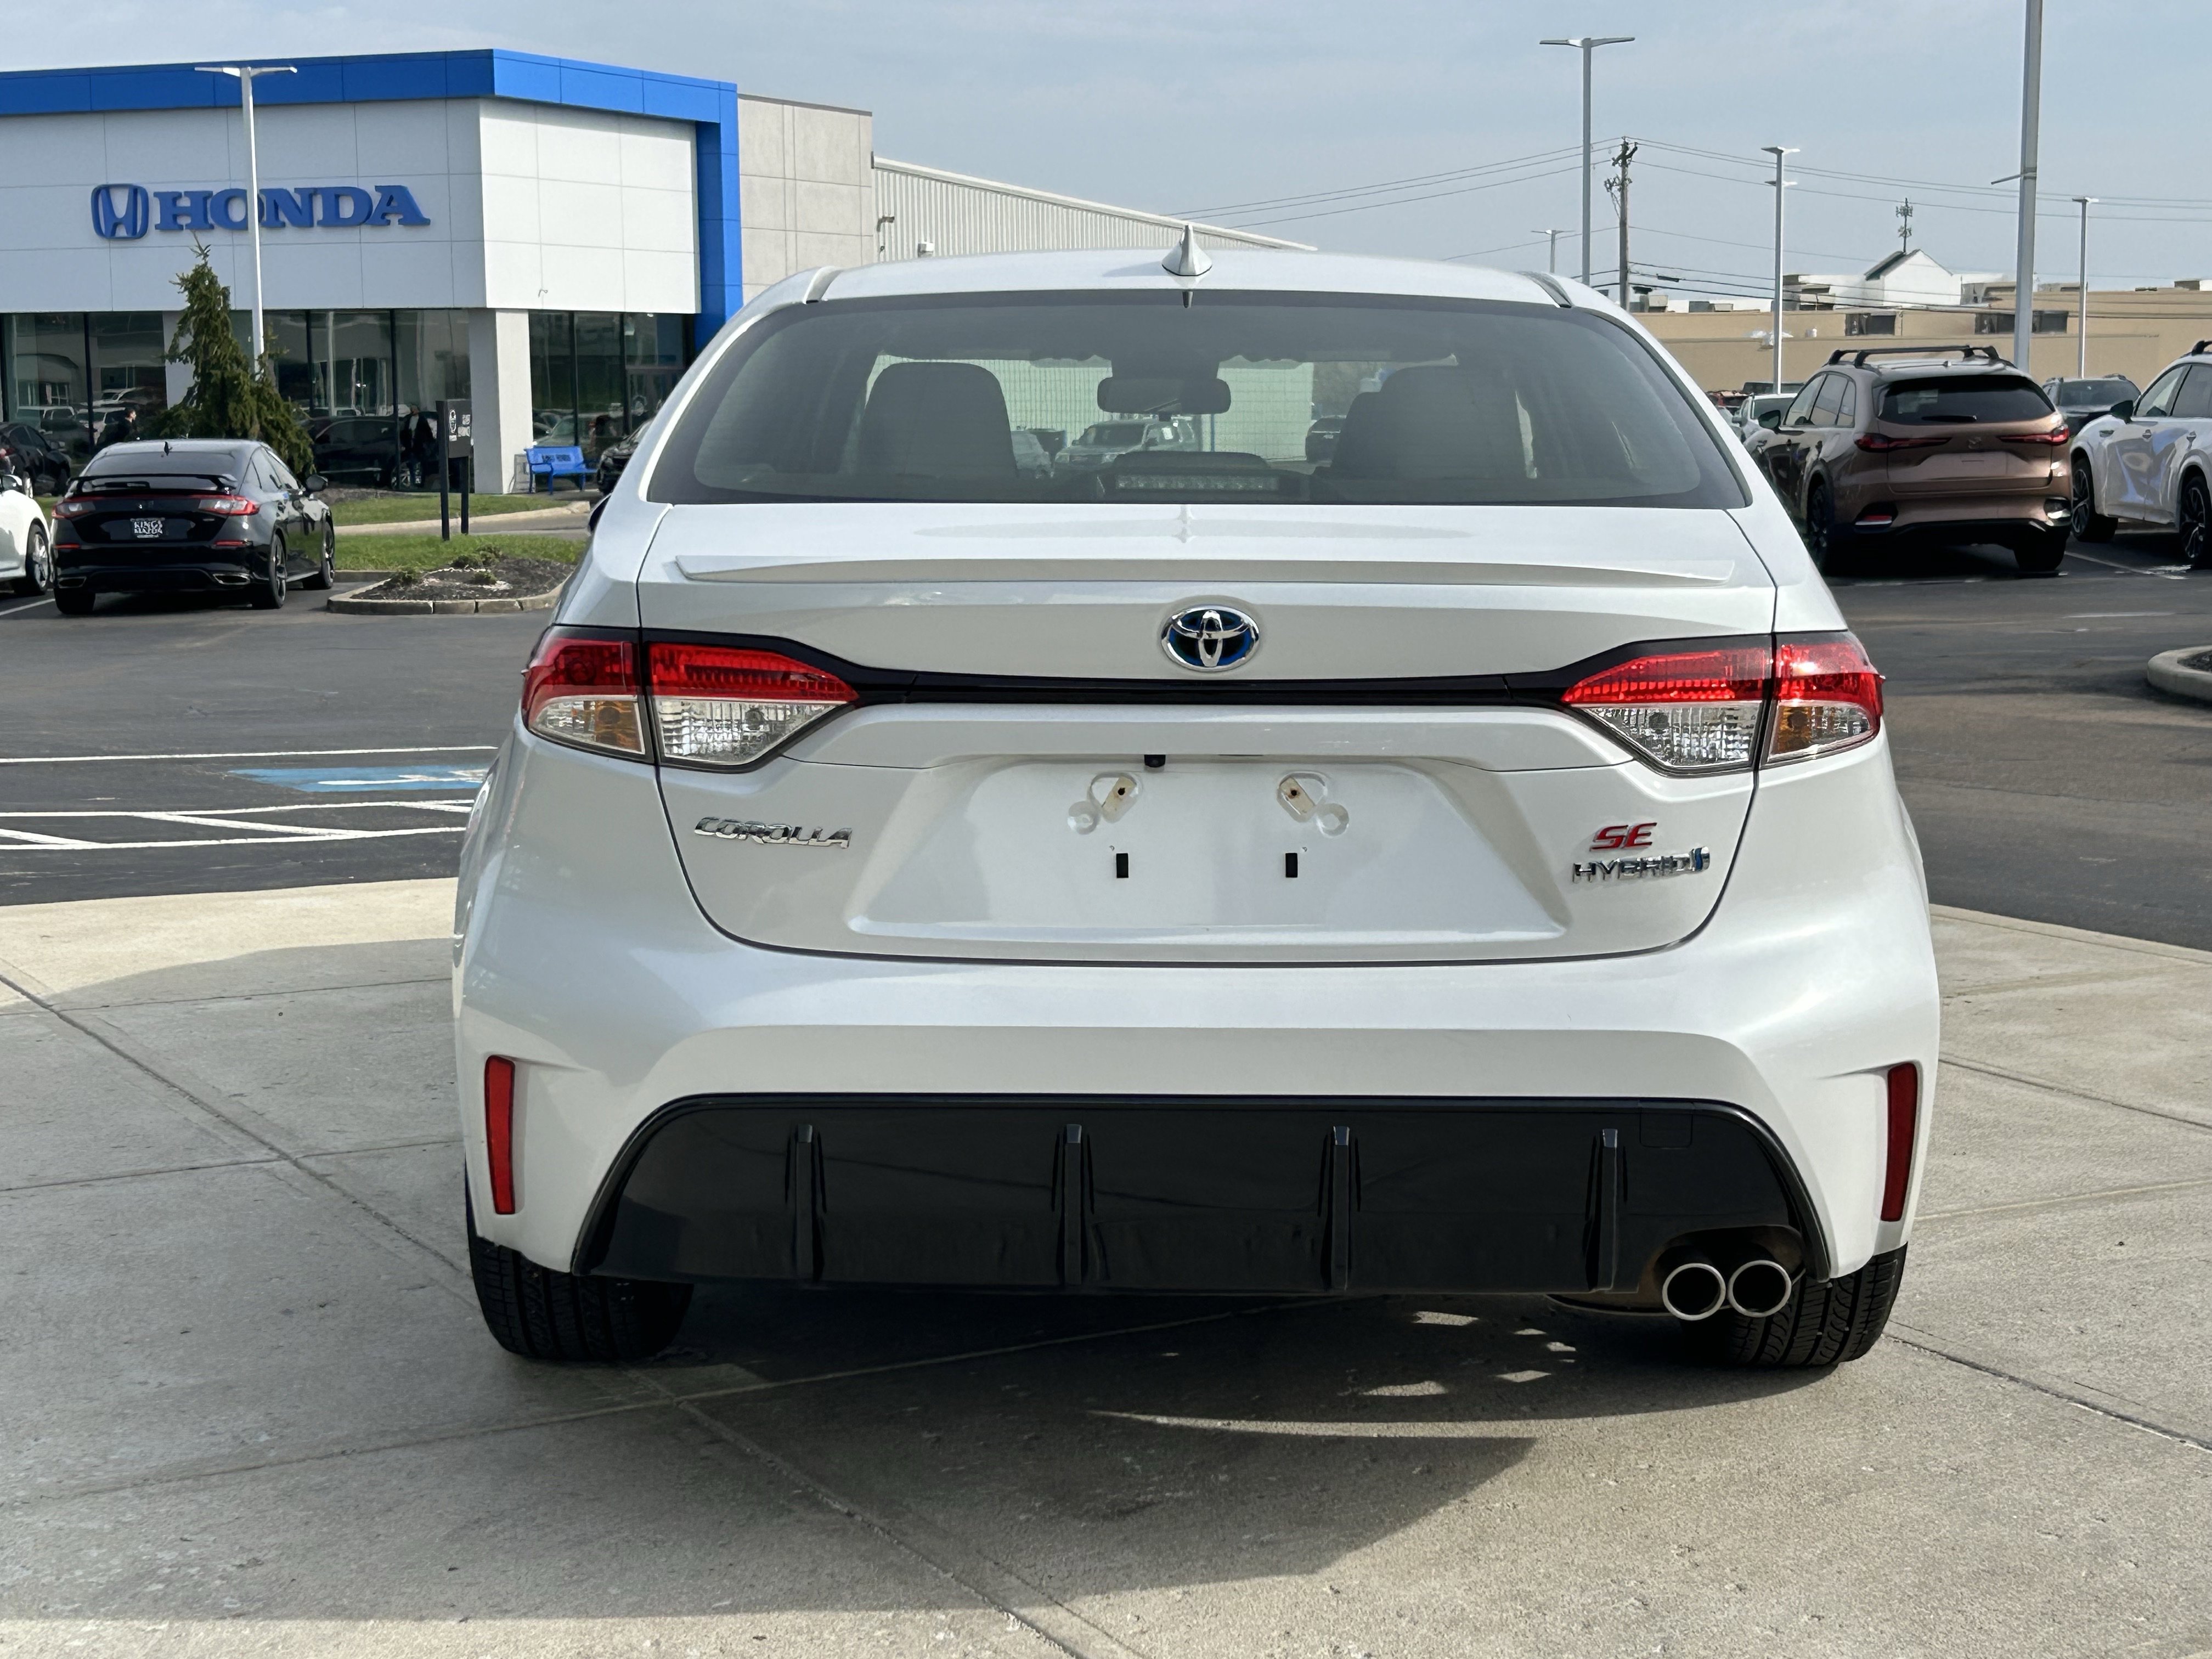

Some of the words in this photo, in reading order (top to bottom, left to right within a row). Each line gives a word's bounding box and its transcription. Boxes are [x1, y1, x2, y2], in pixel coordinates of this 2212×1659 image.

[153, 185, 431, 231] HONDA
[694, 816, 854, 849] COROLLA
[1589, 822, 1658, 852] SE
[1572, 852, 1692, 883] HYBRID
